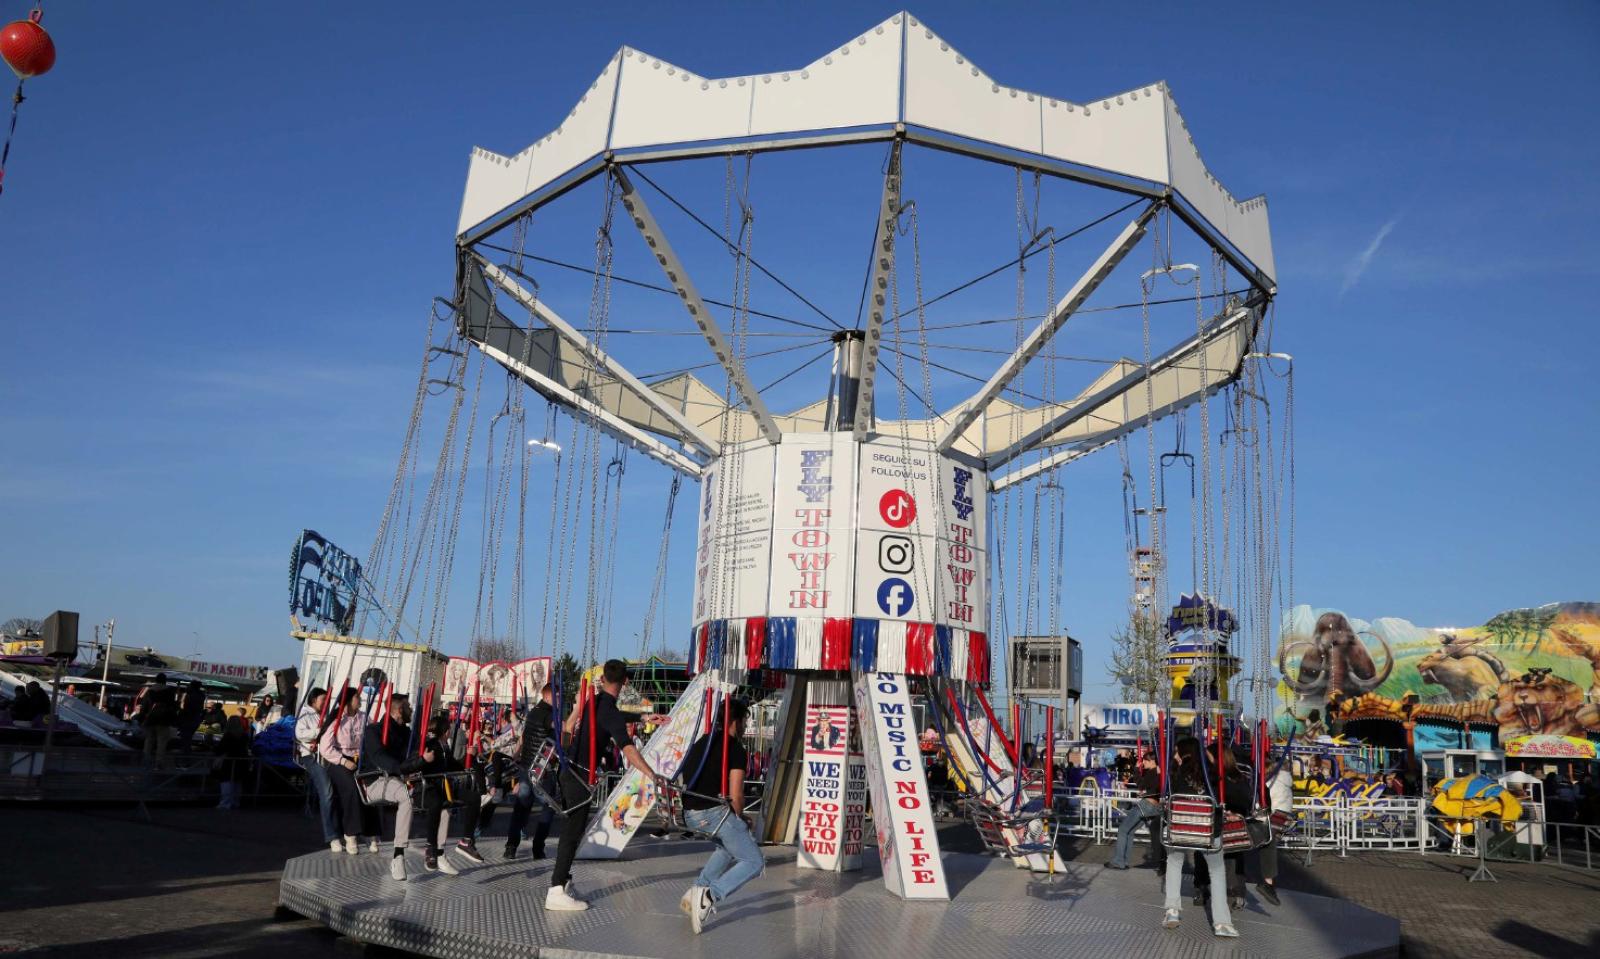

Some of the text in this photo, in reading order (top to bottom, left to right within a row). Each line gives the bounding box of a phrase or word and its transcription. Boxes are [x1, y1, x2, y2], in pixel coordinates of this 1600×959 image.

[913, 458, 926, 467] SU
[797, 450, 833, 502] FLY
[871, 466, 927, 480] FOLLOW US
[951, 466, 974, 522] FLY
[1102, 708, 1143, 725] TIRO
[879, 702, 912, 771] MUSIC
[808, 761, 841, 778] WE
[849, 764, 866, 780] WE
[807, 778, 839, 789] NEED
[848, 781, 865, 790] NEED
[807, 788, 839, 800] YOU
[848, 791, 865, 801] YOU
[894, 781, 921, 810] NO
[805, 801, 839, 812] TO
[847, 804, 864, 813] TO
[804, 812, 838, 828] FLY
[846, 814, 863, 829] FLY
[804, 827, 837, 841] TO
[846, 829, 862, 841] TO
[803, 839, 836, 855] WIN
[845, 843, 862, 856] WIN
[903, 821, 935, 884] LIFE
